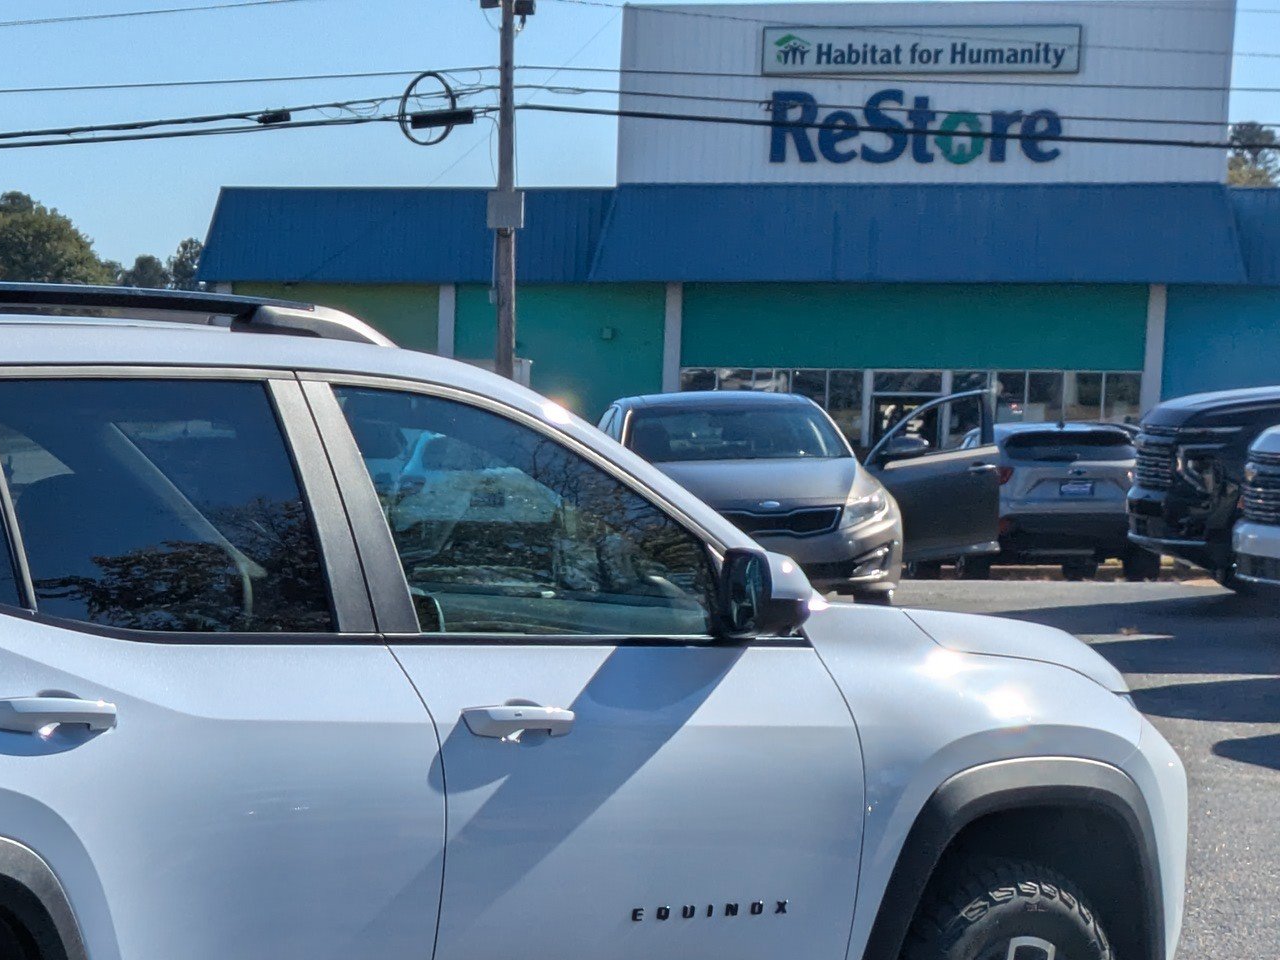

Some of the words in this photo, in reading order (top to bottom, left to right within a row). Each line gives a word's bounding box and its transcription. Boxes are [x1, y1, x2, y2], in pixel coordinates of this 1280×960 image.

[816, 42, 905, 65] Habitat
[910, 42, 943, 65] for
[950, 42, 1066, 68] Humanity
[769, 88, 1063, 165] ReStore
[631, 900, 789, 922] EQUINOX
